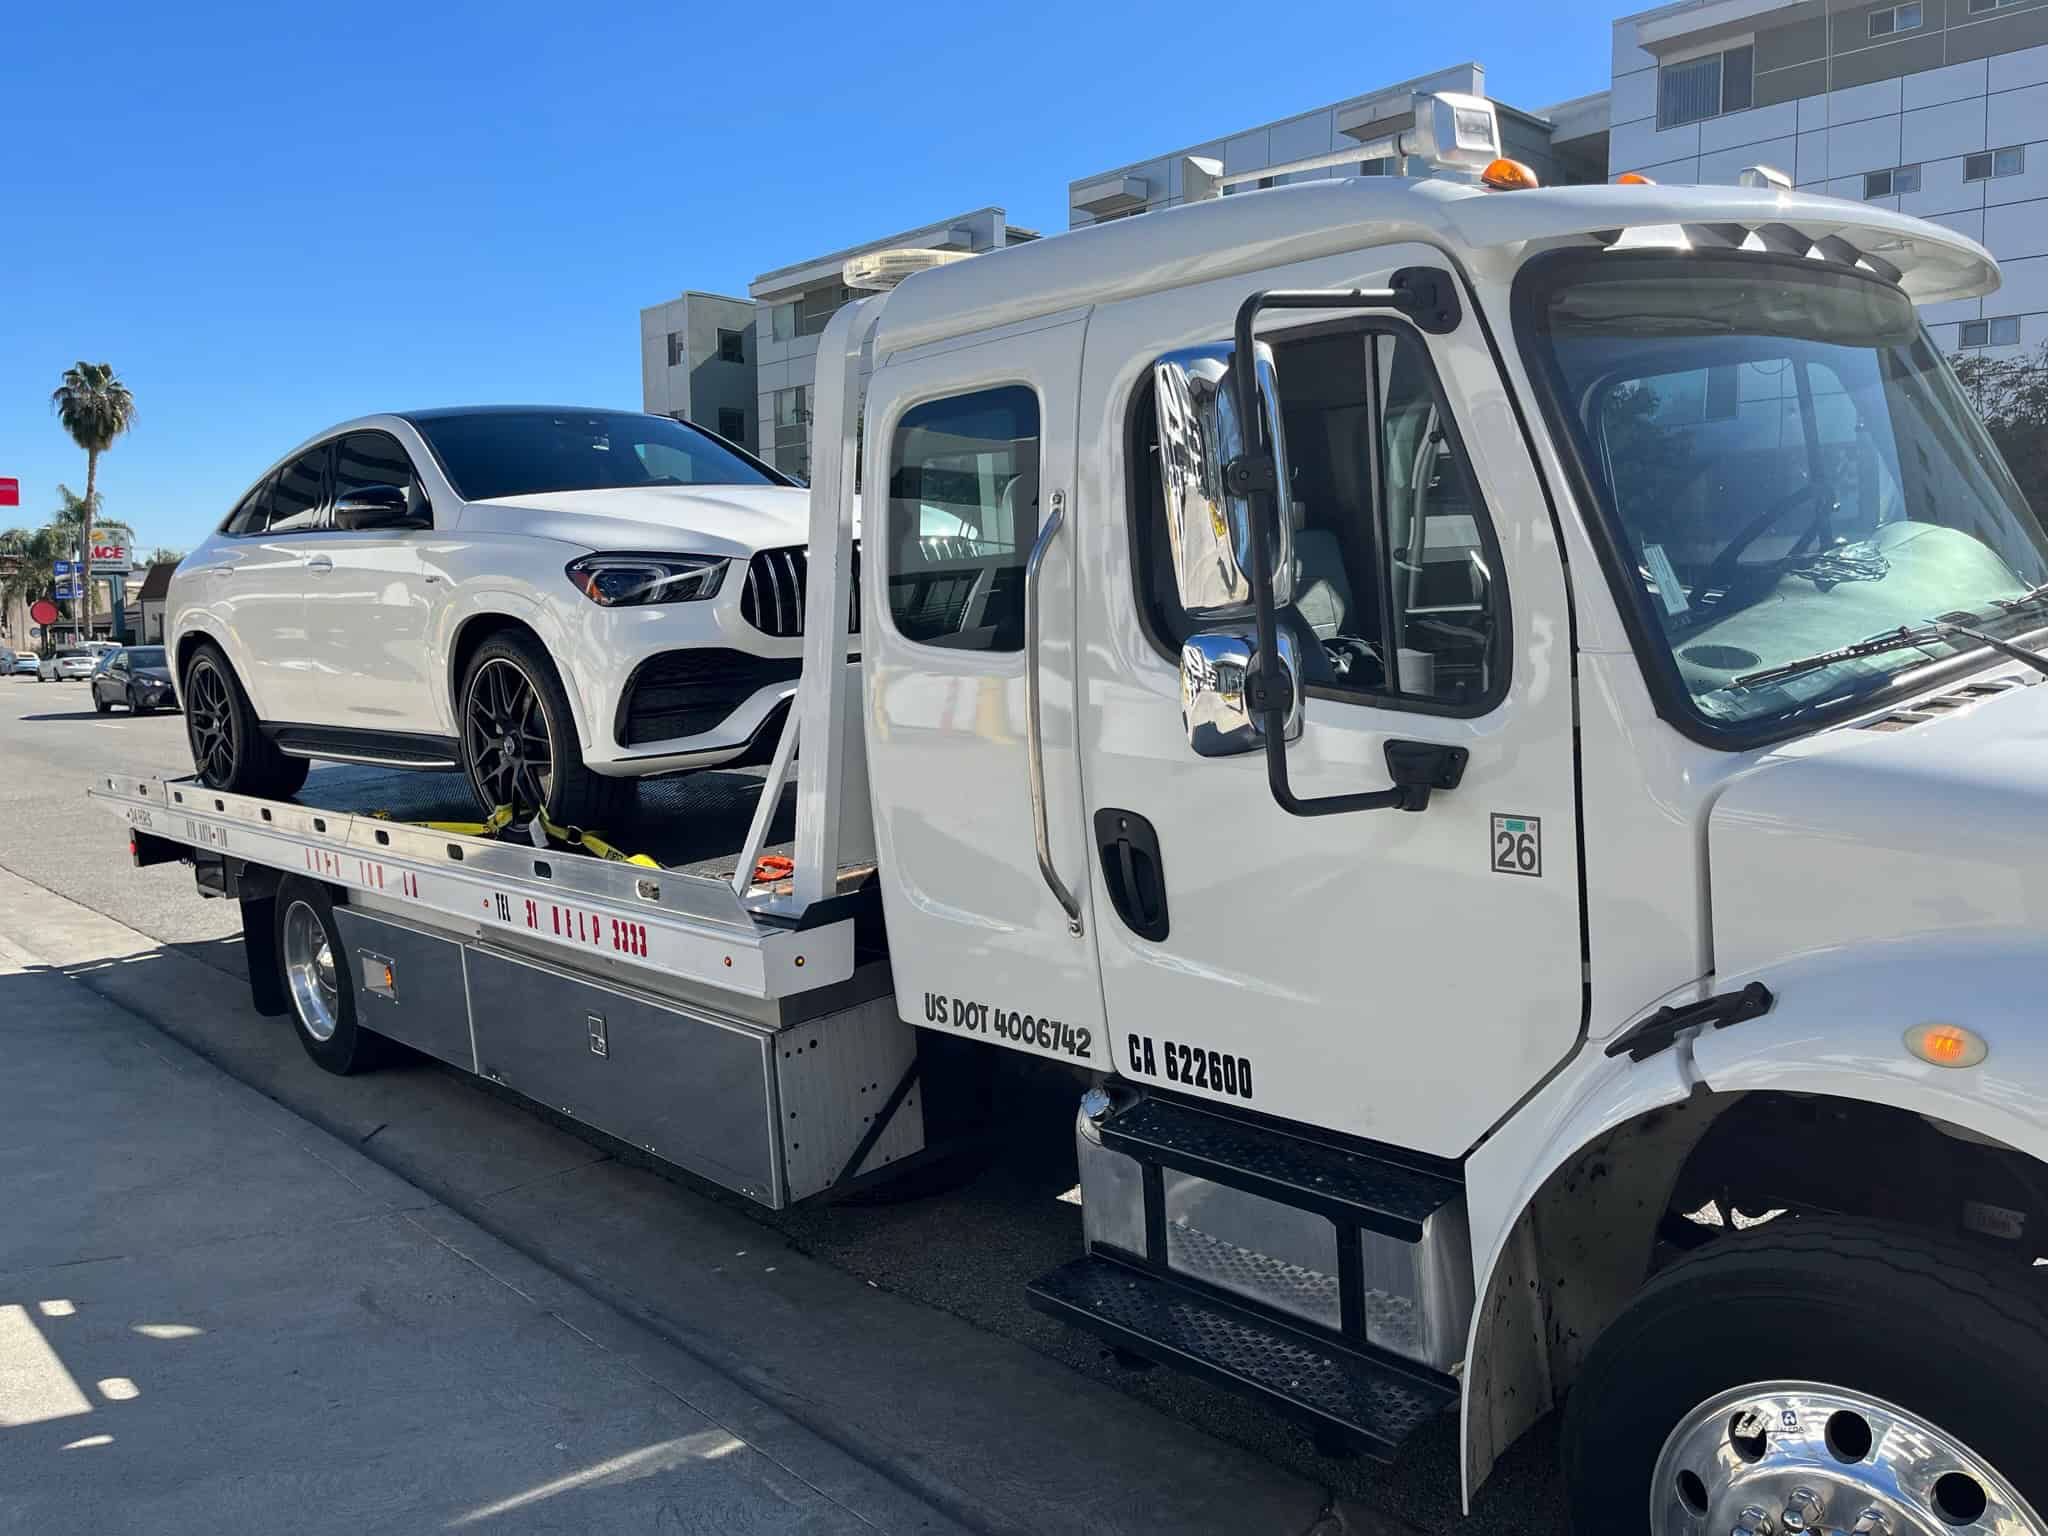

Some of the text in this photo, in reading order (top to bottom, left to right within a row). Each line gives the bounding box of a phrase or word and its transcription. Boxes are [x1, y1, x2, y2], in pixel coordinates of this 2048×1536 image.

[91, 545, 124, 559] ACE
[1496, 831, 1536, 871] 26
[495, 892, 511, 922] TEL
[612, 919, 648, 958] 3333
[924, 991, 1092, 1059] US DOT 4006742
[1127, 1033, 1253, 1100] CA 622600
